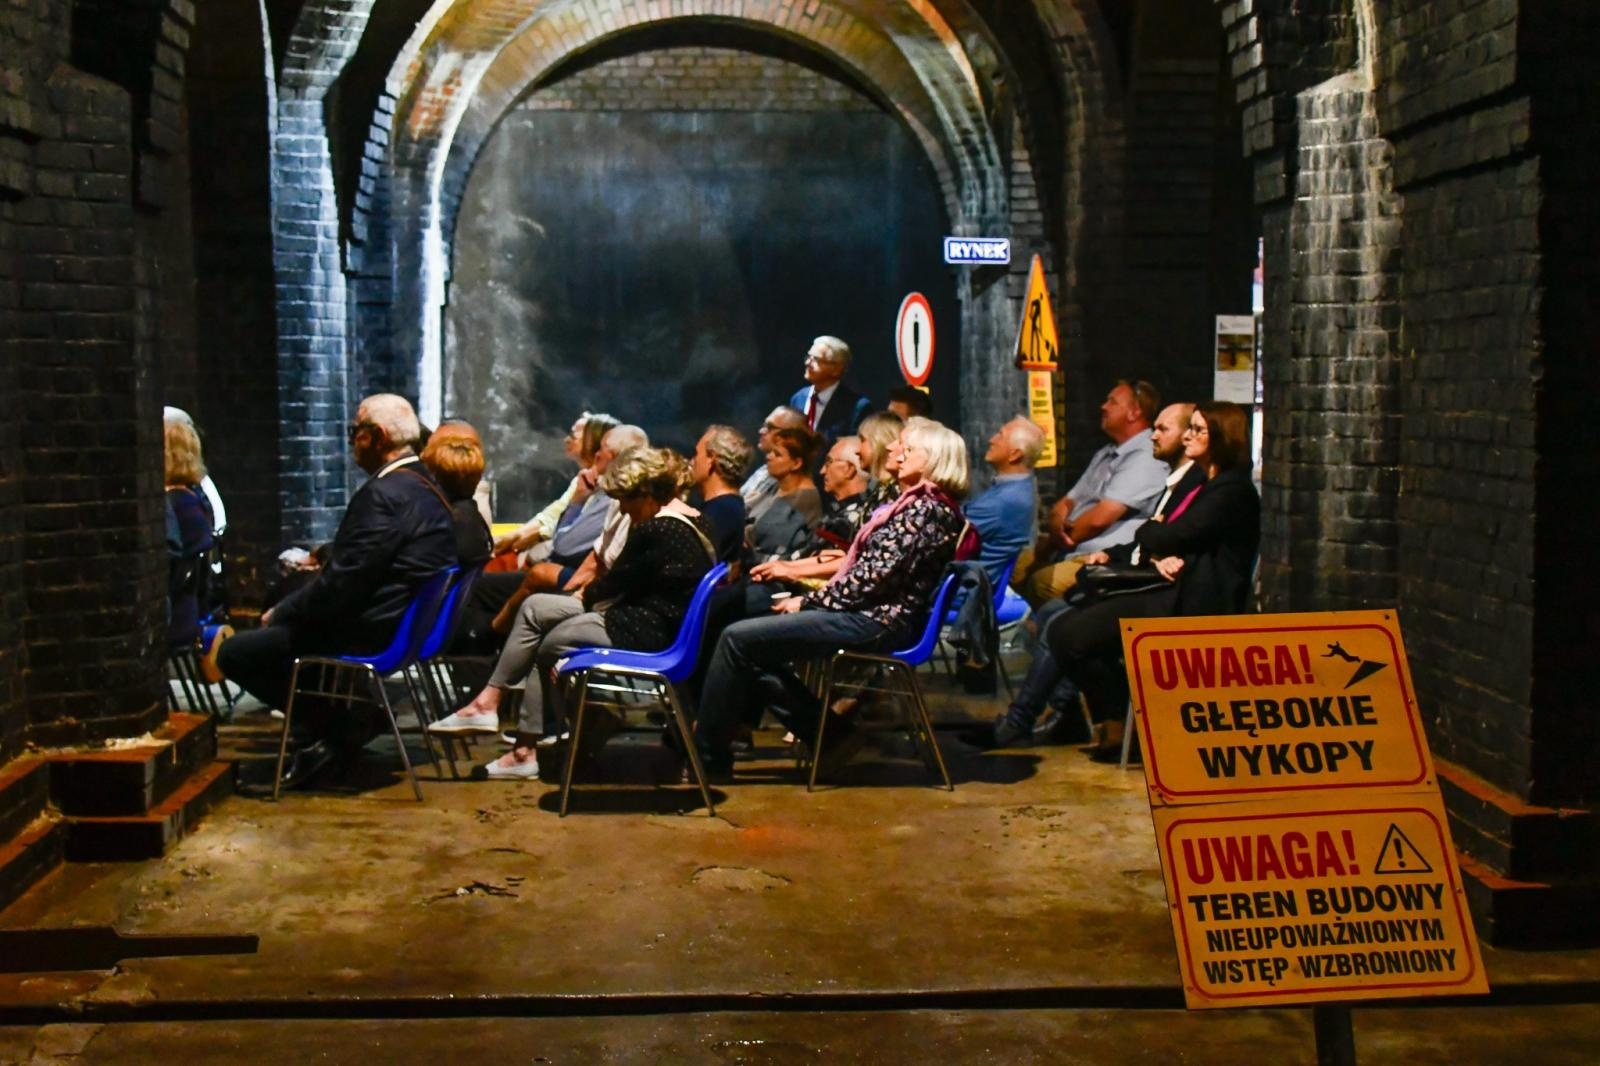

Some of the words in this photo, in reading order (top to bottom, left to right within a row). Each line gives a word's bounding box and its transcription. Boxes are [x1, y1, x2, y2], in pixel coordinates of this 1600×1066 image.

[949, 242, 1008, 259] RYNEK
[1150, 644, 1315, 691] UWAGA!
[1180, 695, 1378, 738] GŁĘBOKIE
[1197, 740, 1375, 779] WYKOPY
[1182, 829, 1361, 885] UWAGA!
[1188, 890, 1299, 923] TEREN
[1307, 883, 1444, 916] BUDOWY
[1206, 916, 1445, 953] NIEUPOWAŻNIONYM
[1203, 957, 1290, 987] WSTĘP
[1298, 948, 1457, 978] WZBRONIONY
